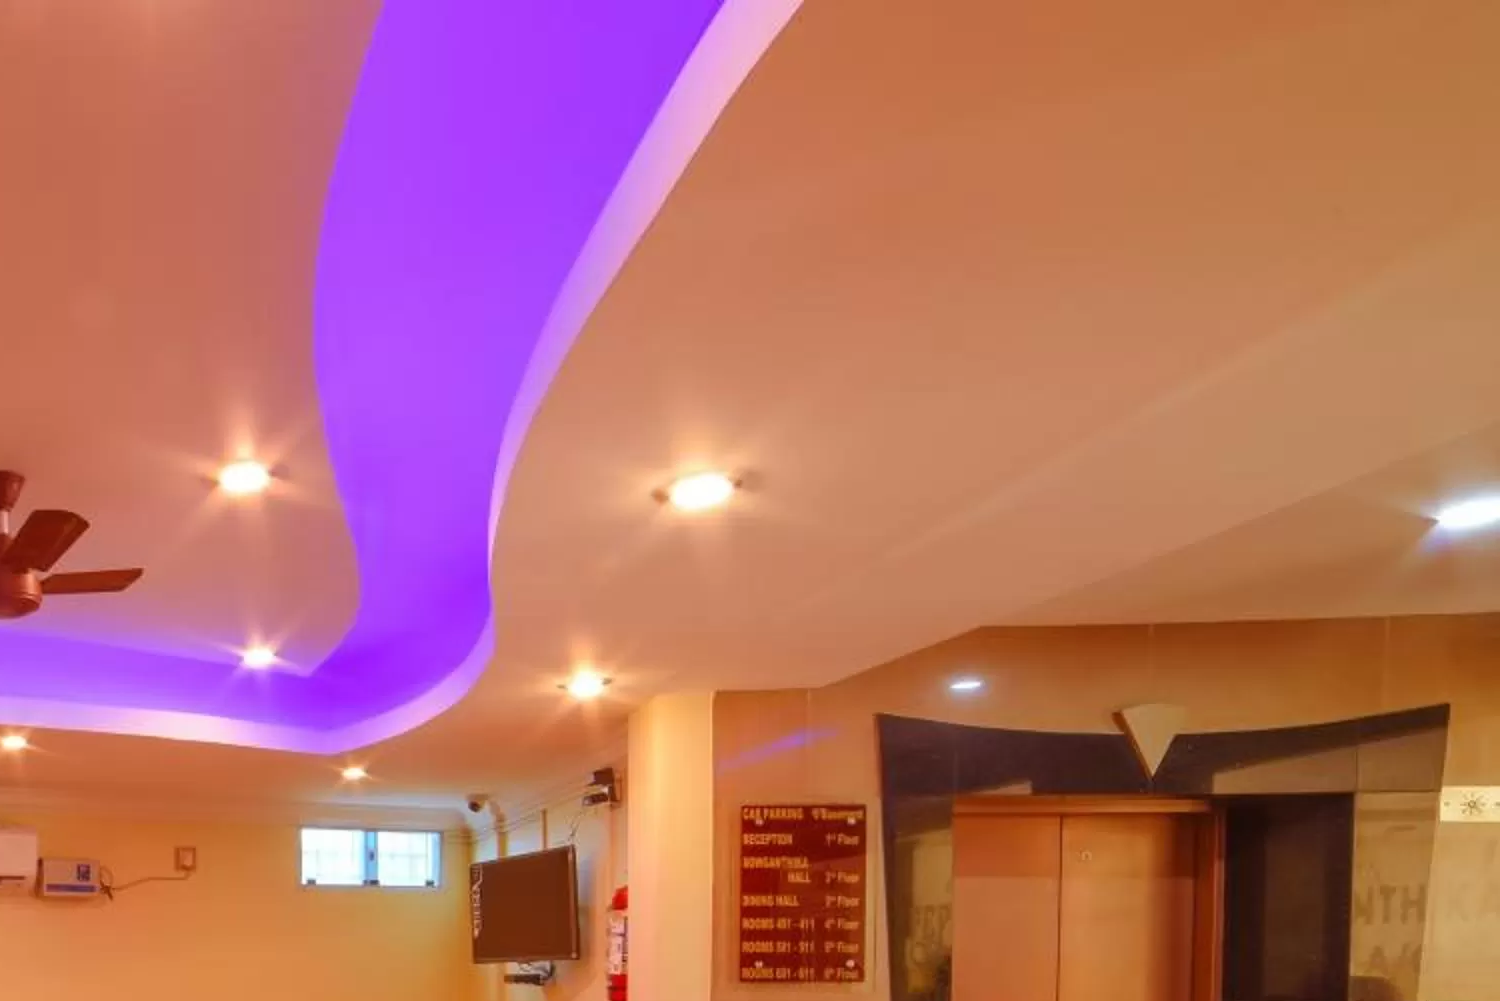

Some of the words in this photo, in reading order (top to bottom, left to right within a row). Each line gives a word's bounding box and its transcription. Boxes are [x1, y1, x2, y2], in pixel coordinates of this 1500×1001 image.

[764, 807, 803, 820] PARKING
[743, 833, 793, 845] RECEPTION
[837, 833, 860, 845] Floor
[787, 871, 811, 883] HALL
[837, 871, 860, 884] Floor
[742, 895, 774, 907] DINING
[775, 895, 800, 907] HALL
[837, 895, 860, 907] Floor
[742, 917, 774, 929] ROOMS
[837, 917, 860, 929] Floor
[742, 941, 774, 953] ROOMS
[837, 941, 859, 953] Floor
[741, 967, 774, 979] ROOMS
